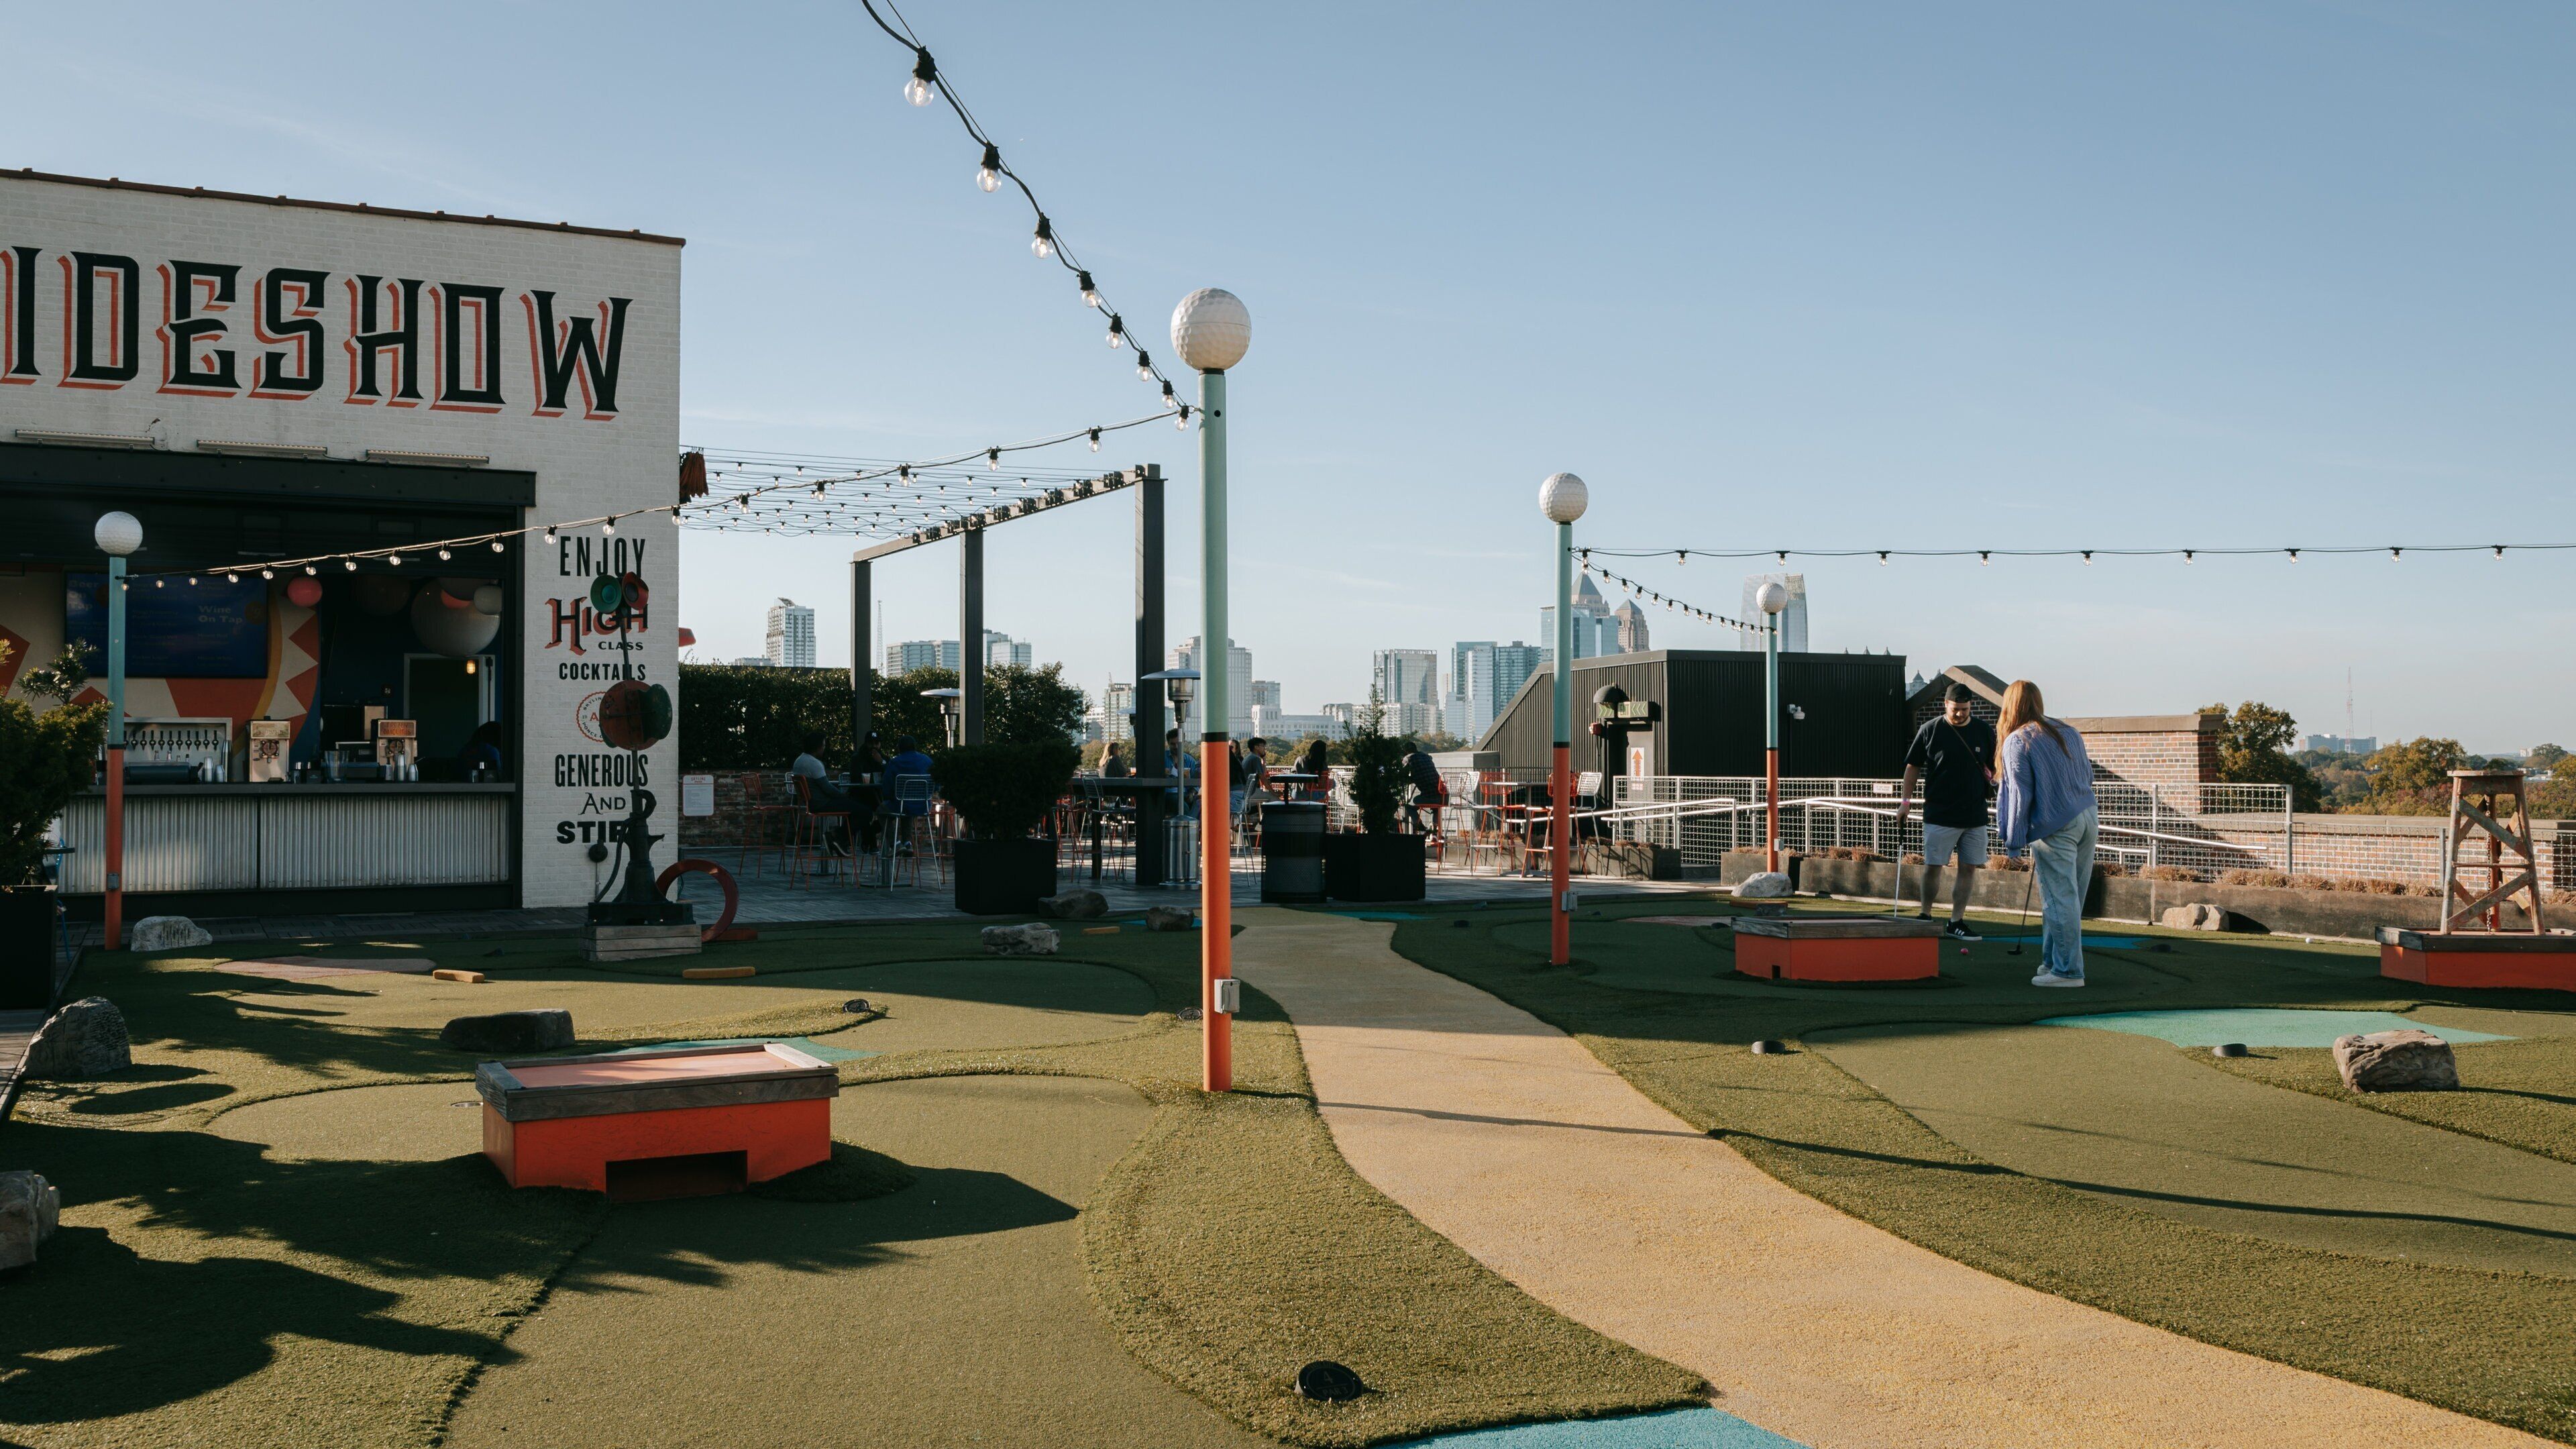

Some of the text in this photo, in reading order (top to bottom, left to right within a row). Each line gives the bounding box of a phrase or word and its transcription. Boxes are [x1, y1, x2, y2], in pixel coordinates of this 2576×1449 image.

[560, 536, 645, 577] ENJOY
[69, 602, 93, 611] Tap
[198, 605, 231, 613] Wine
[219, 615, 243, 625] Tap
[598, 641, 643, 650] CLASS
[559, 663, 645, 680] COCKTAILS
[583, 697, 602, 710] SKYLIN
[555, 754, 648, 787] GENEROUS
[578, 792, 626, 815] AND
[1324, 1371, 1334, 1384] 4
[1322, 1386, 1348, 1396] PAR 3
